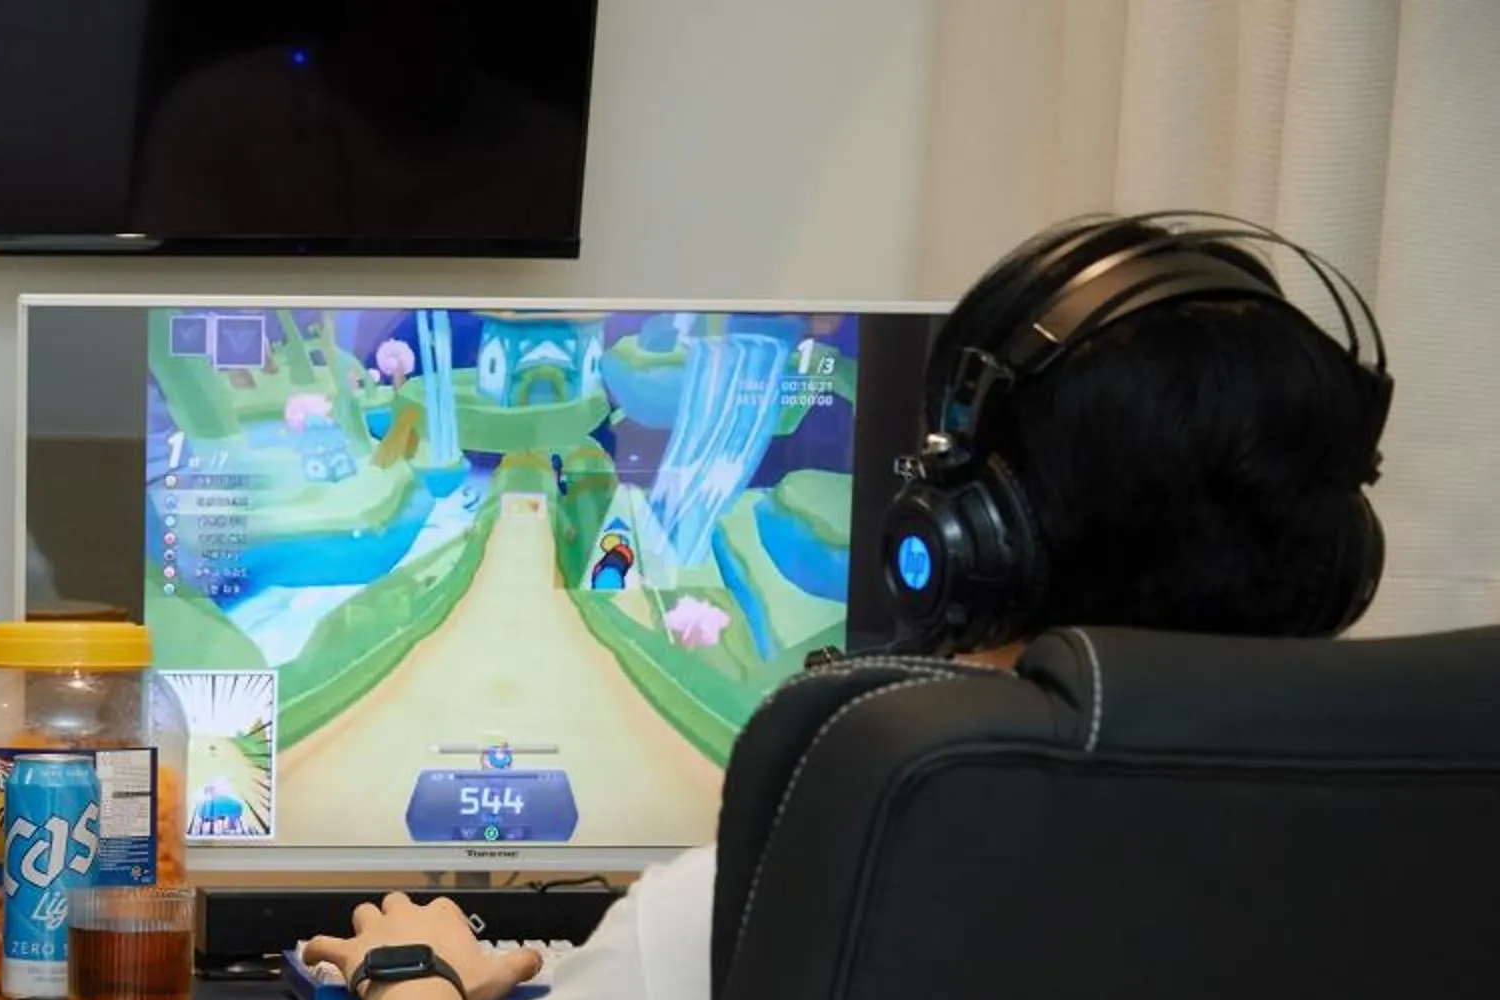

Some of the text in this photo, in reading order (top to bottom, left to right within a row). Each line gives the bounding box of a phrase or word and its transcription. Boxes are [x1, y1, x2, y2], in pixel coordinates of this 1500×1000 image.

[460, 787, 524, 815] 544
[31, 888, 68, 930] Lig
[10, 941, 55, 957] ZERO
